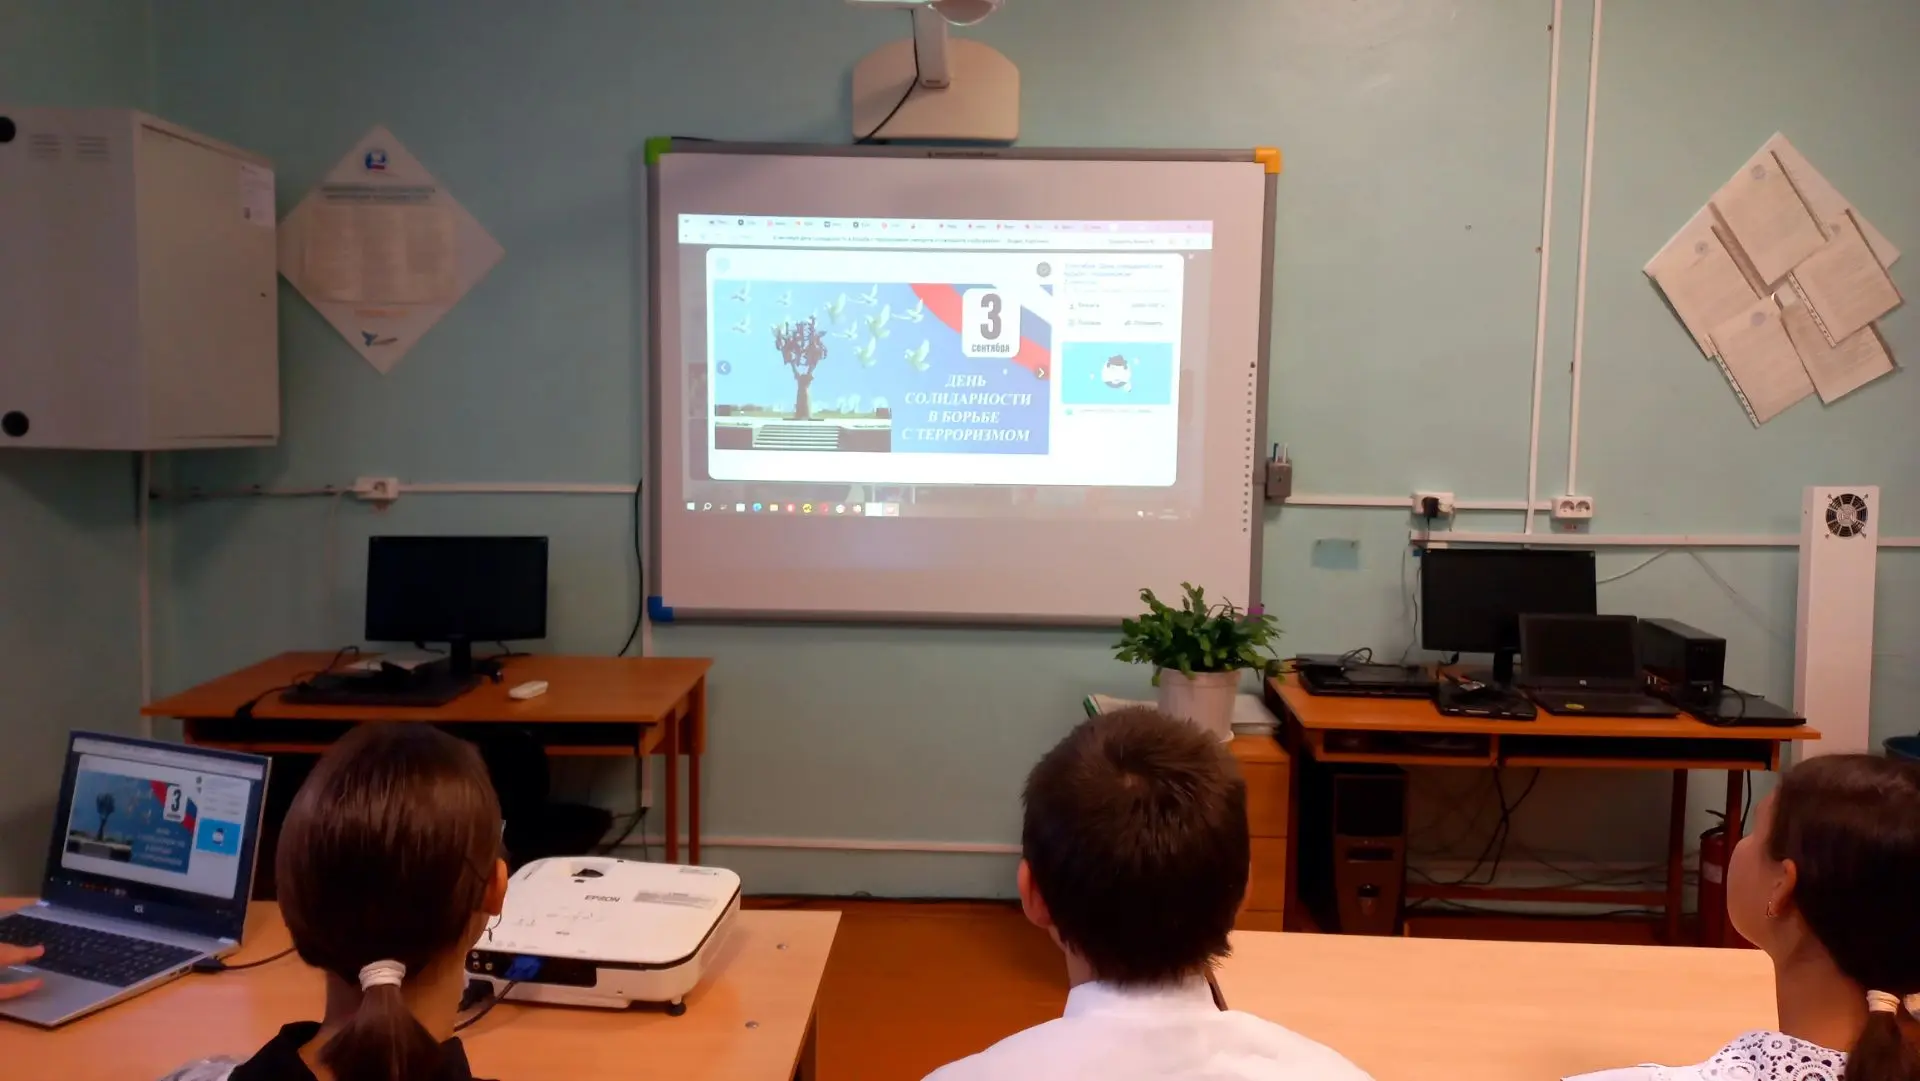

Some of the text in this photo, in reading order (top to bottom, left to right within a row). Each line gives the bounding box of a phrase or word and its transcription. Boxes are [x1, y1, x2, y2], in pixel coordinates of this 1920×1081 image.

[980, 293, 1002, 340] 3
[971, 343, 1010, 353] сентября
[945, 374, 987, 388] ДЕНЬ
[905, 391, 1032, 406] СОЛИДАРНОСТИ
[927, 410, 1000, 424] В БОРЬБЕ
[901, 428, 1031, 442] С ТЕРРОРИЗМОМ
[171, 788, 182, 813] 3
[584, 894, 621, 903] EPSON
